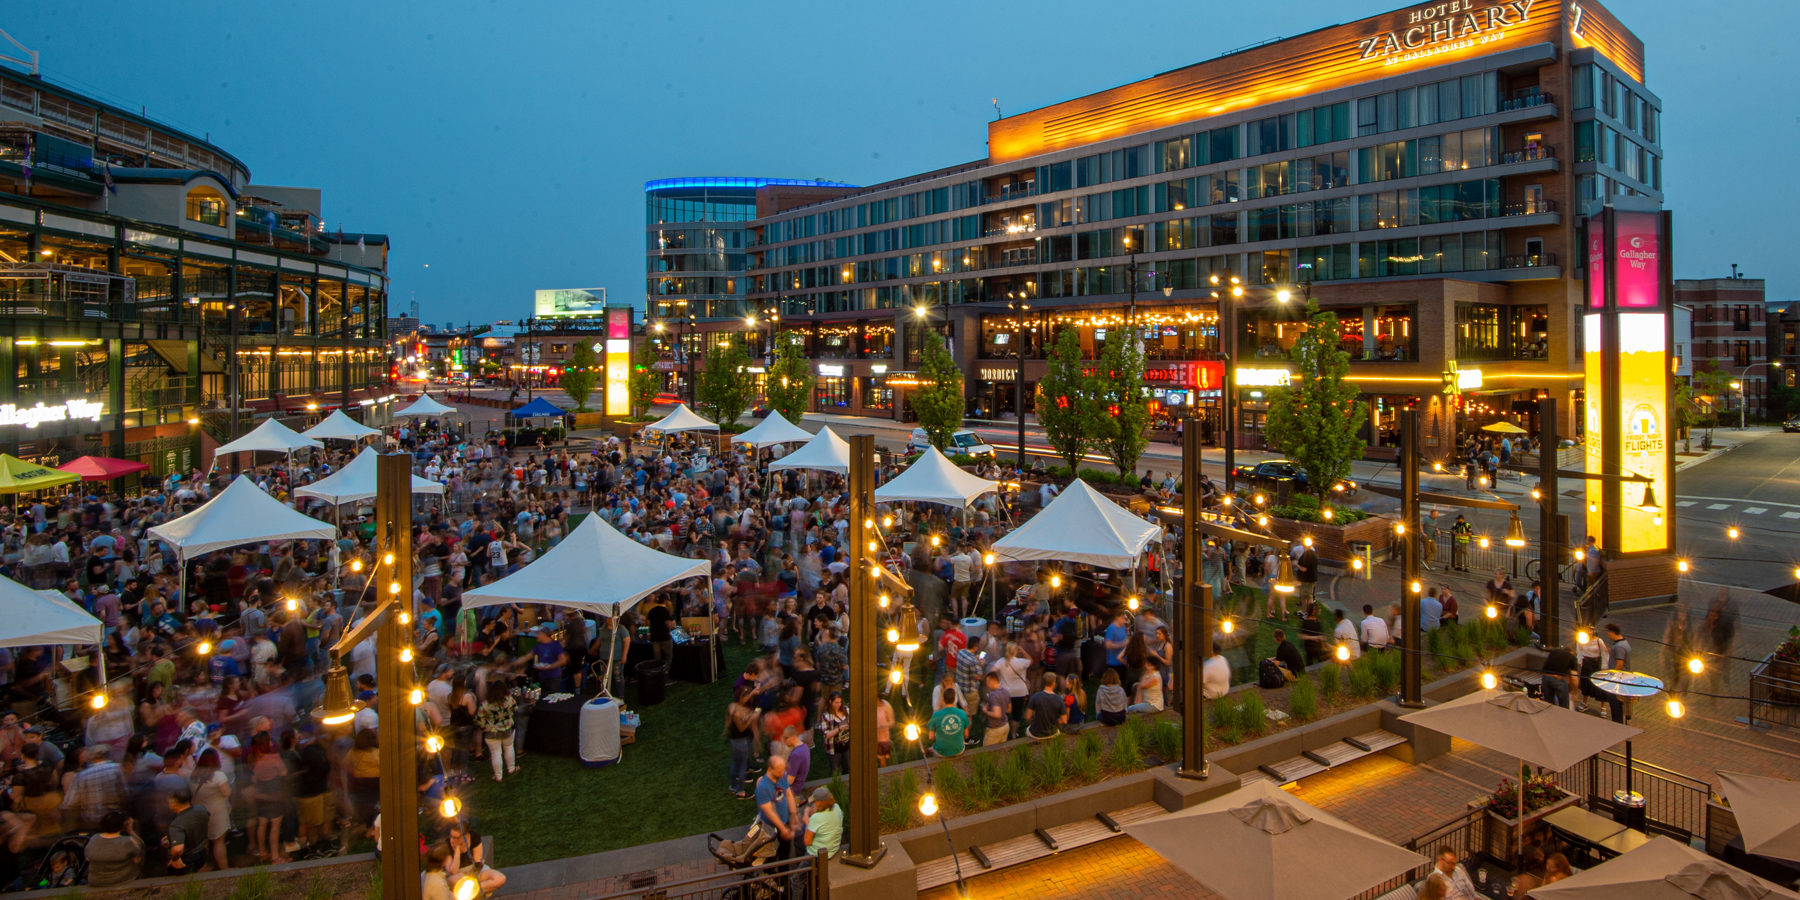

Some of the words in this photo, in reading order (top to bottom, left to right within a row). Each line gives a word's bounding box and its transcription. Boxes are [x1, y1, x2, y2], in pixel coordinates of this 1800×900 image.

[1409, 0, 1472, 24] HOTEL
[1358, 0, 1534, 62] ZACHARY
[1385, 56, 1398, 66] AT
[1480, 32, 1504, 44] WAY
[1619, 250, 1656, 260] Gallagher
[1630, 260, 1646, 270] Way
[980, 368, 1019, 381] MORDECA
[66, 399, 104, 422] Way
[1625, 440, 1663, 451] FLIGHTS
